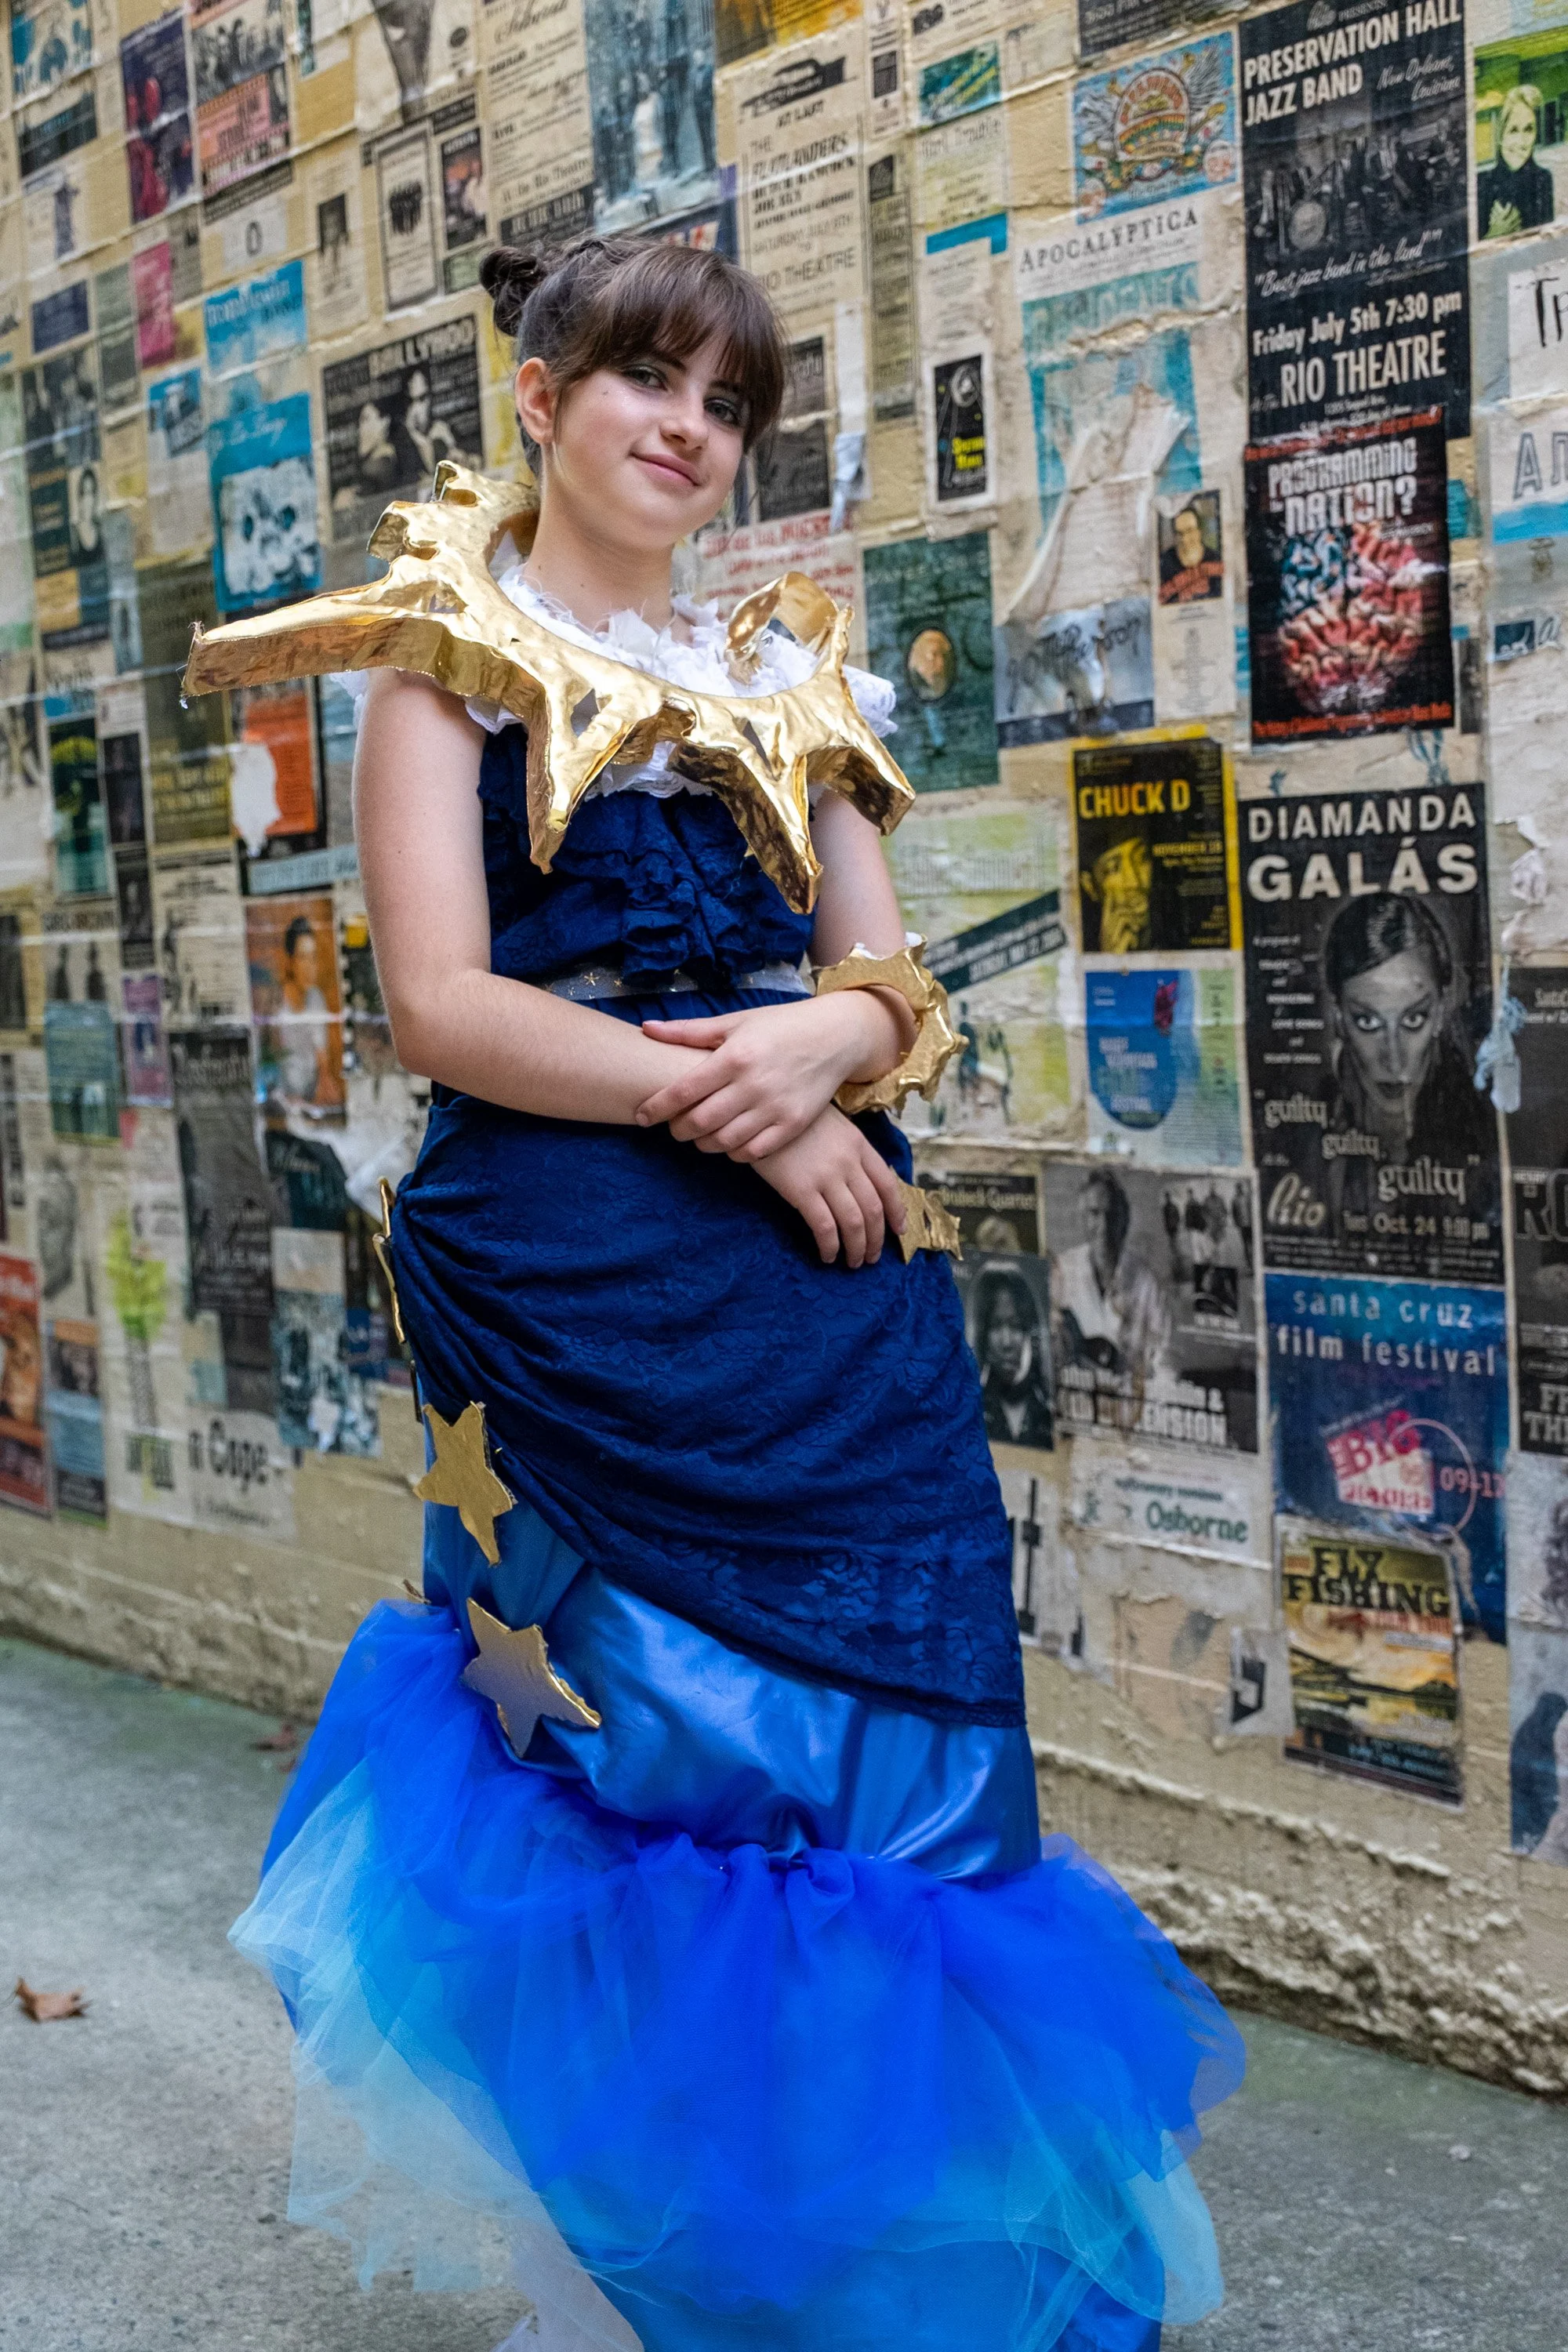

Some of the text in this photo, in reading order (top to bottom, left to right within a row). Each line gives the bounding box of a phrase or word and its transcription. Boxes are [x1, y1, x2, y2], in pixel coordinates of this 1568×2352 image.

[1243, 0, 1461, 90] PRESERVATION HALL
[1244, 63, 1363, 127] JAZZ BAND
[1019, 206, 1199, 274] APOCALYPTICA
[1254, 291, 1463, 356] Friday July 5th 7:30 pm
[1280, 357, 1326, 408] RIO
[1333, 330, 1447, 396] THEATRE
[1078, 778, 1191, 818] CHUCK D
[1248, 792, 1476, 843] DIAMANDA
[1247, 836, 1479, 902] GALÁS
[1293, 1290, 1474, 1330] santa cruz
[1277, 1323, 1344, 1362] film
[1361, 1331, 1496, 1377] festival
[1145, 1500, 1248, 1544] Osborne
[1314, 1547, 1383, 1581] FLY
[1285, 1574, 1450, 1617] FISHING
